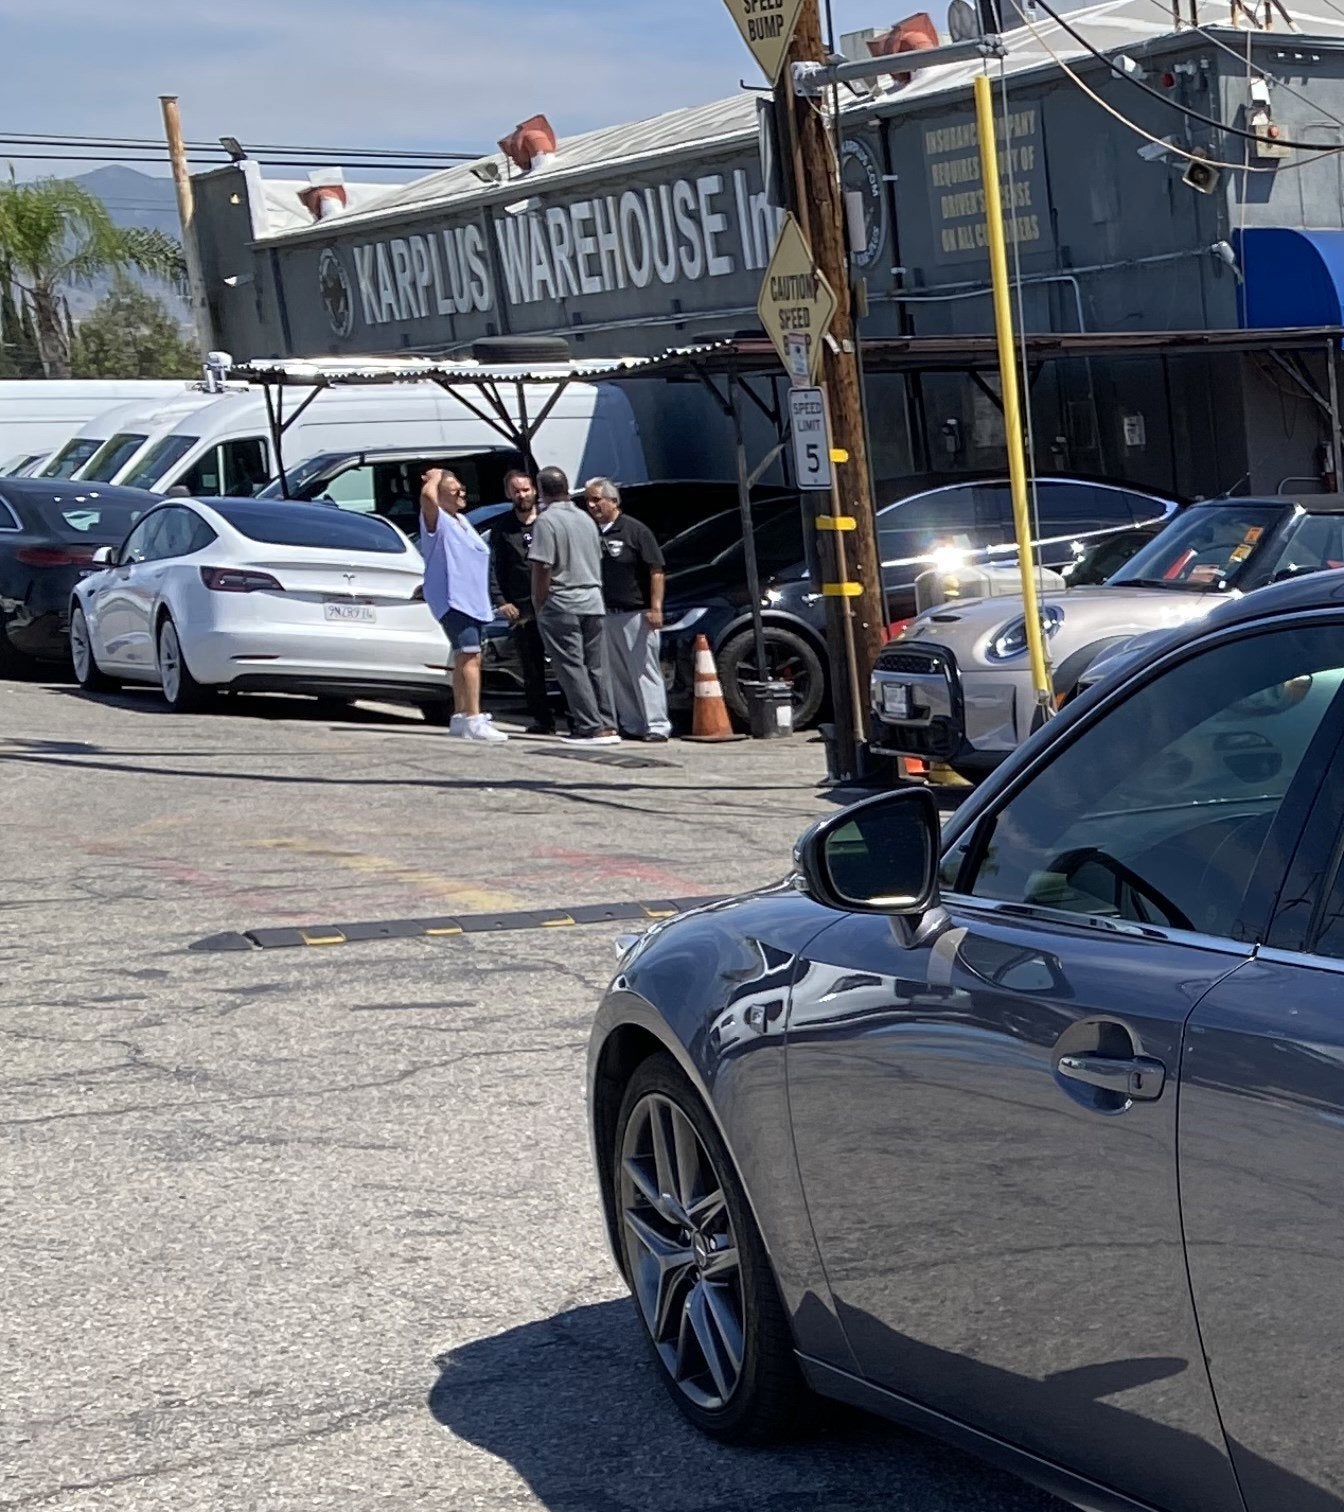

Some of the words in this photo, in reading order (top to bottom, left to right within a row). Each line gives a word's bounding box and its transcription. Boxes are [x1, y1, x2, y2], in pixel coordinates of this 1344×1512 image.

[748, 14, 783, 41] BUMP
[1020, 145, 1034, 172] OF
[353, 224, 494, 325] KARPLUS
[495, 174, 734, 305] WAREHOUSE
[771, 274, 817, 301] CAUTION
[779, 307, 810, 330] SPEED
[783, 333, 812, 355] BP
[793, 401, 822, 415] SPEED
[797, 419, 821, 432] LIMIT
[805, 443, 821, 473] 5
